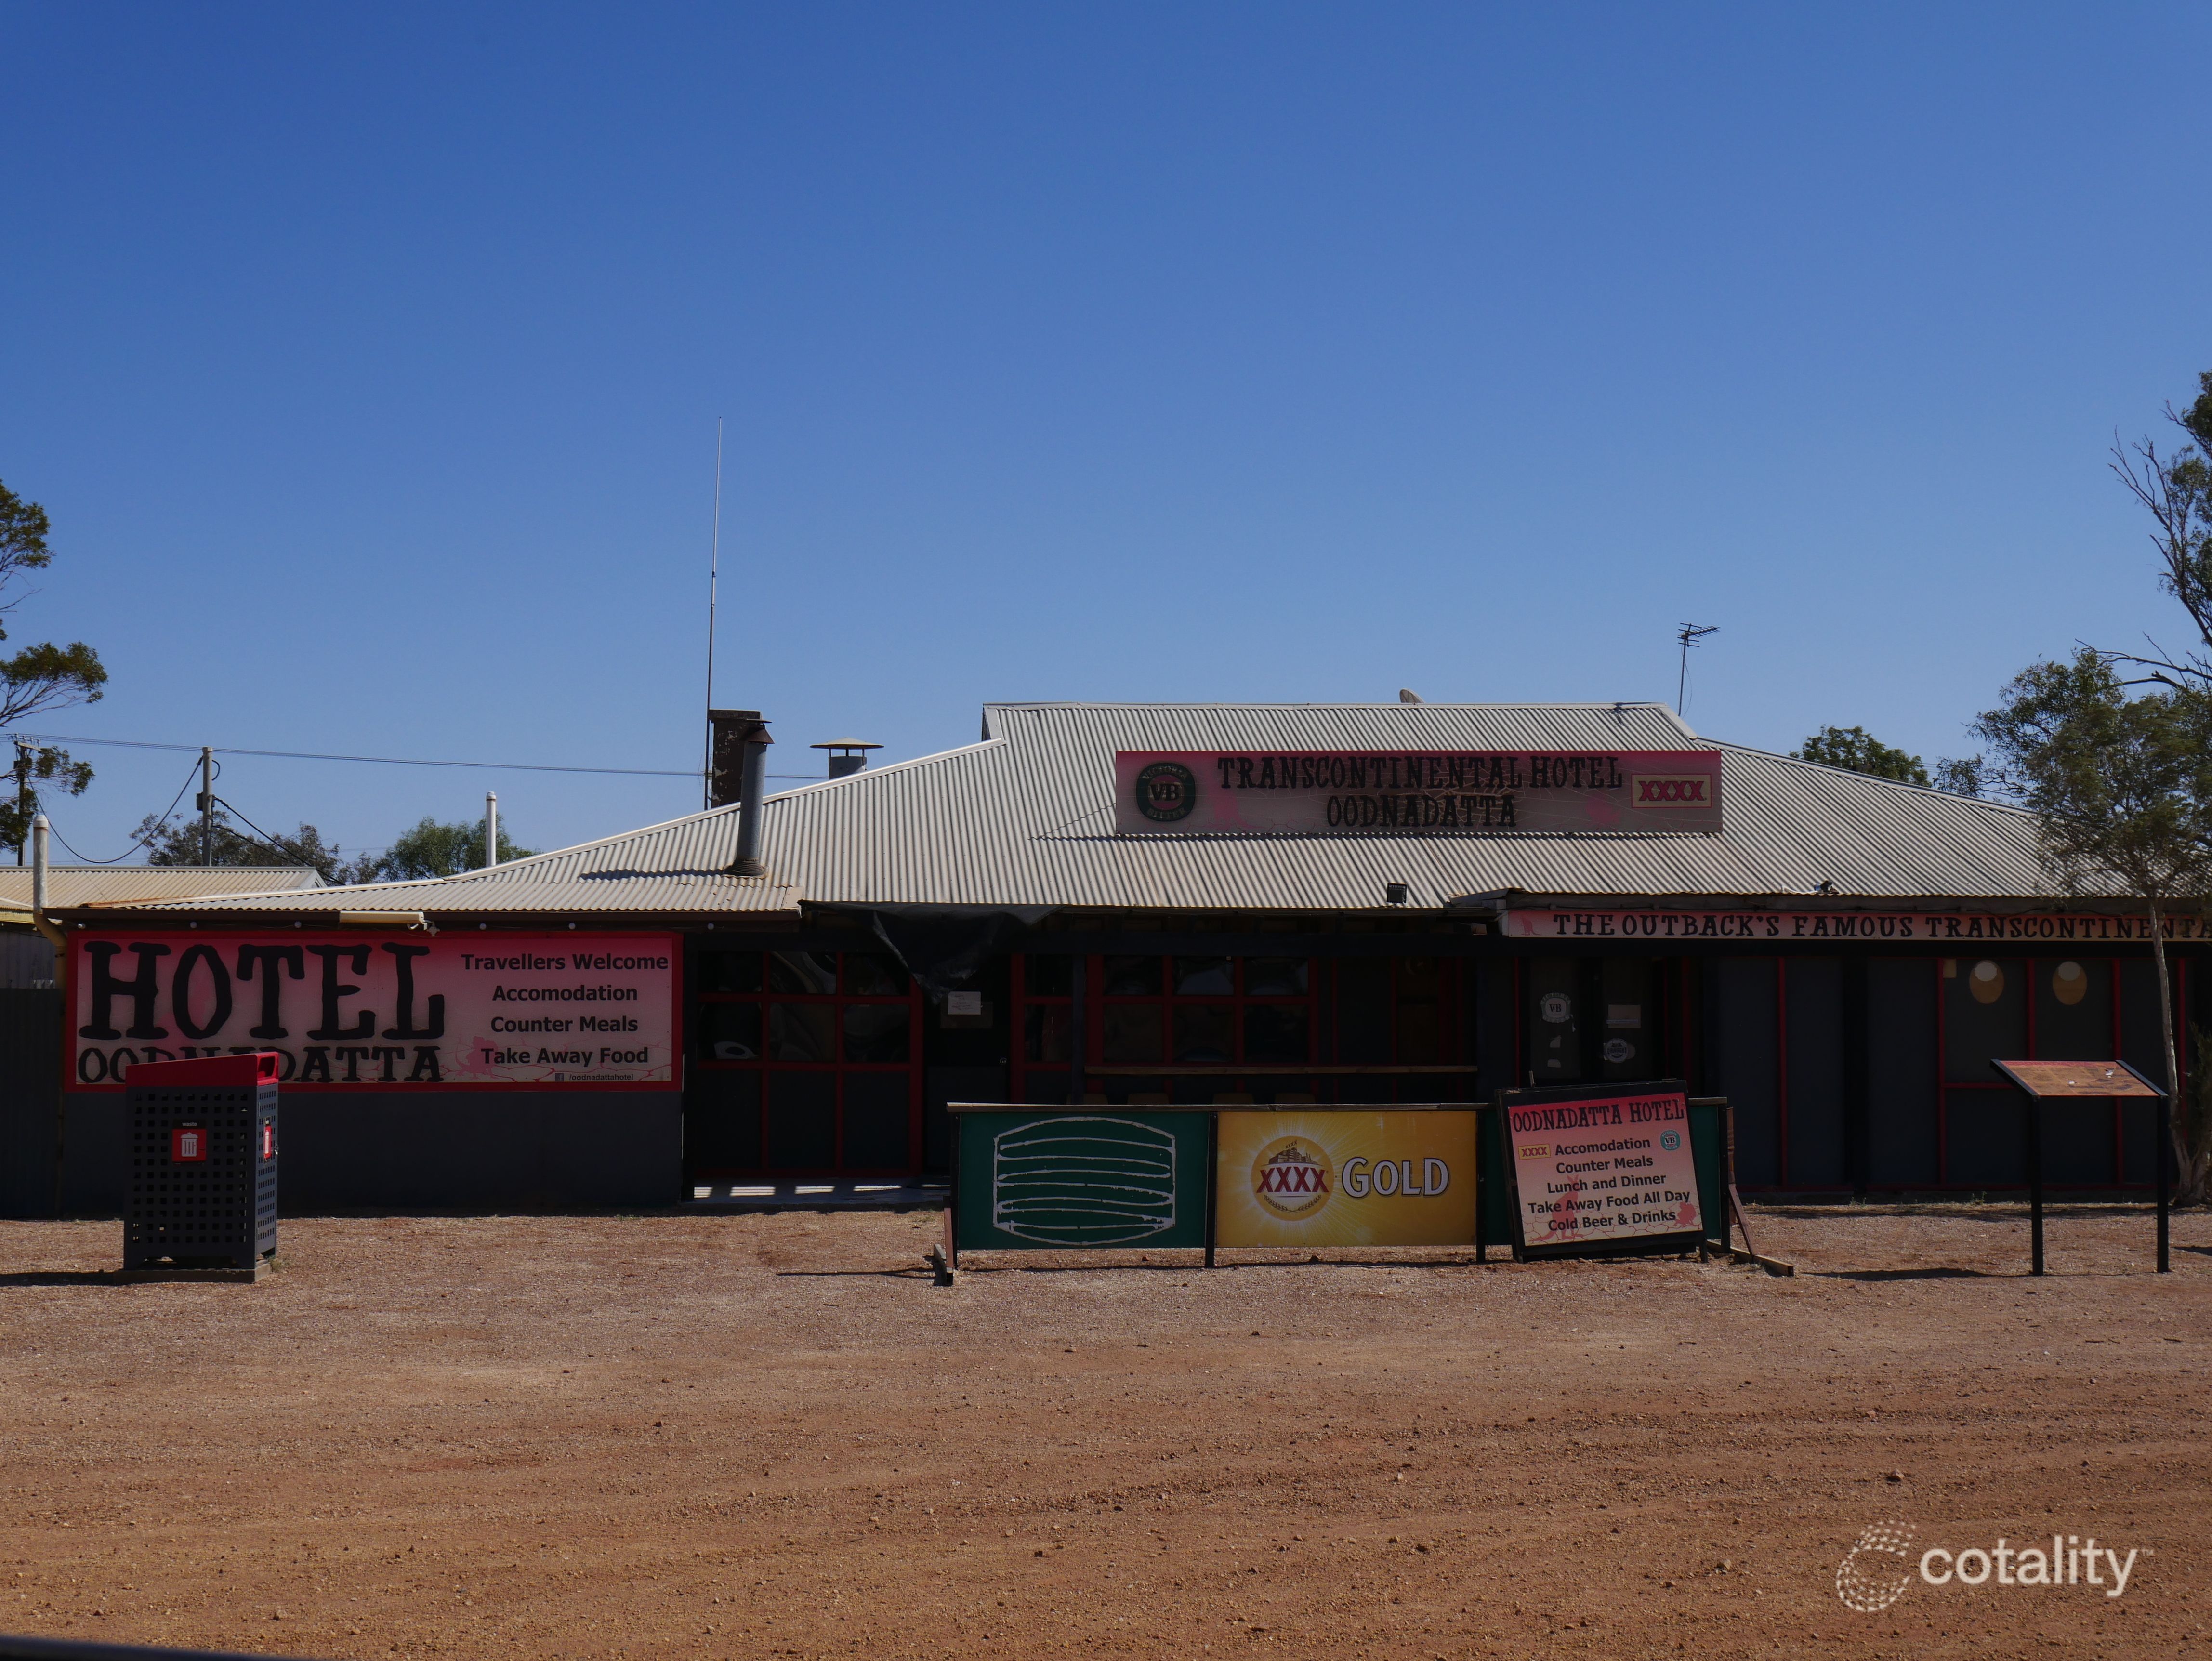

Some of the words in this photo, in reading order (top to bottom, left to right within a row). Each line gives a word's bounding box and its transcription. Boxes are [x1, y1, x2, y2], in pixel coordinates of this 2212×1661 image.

[1217, 756, 1522, 789] TRANSCONTINENTAL
[1529, 756, 1622, 789] HOTEL
[1148, 784, 1181, 801] VB
[1639, 780, 1705, 801] XXXX
[1327, 795, 1517, 827] OODNADATTA
[1554, 914, 1615, 935] THE
[1622, 915, 1779, 936] OUTBACK'S
[1791, 916, 1913, 937] FAMOUS
[461, 953, 566, 970] Travellers
[572, 953, 669, 970] Welcome
[79, 941, 445, 1040] HOTEL
[492, 985, 637, 1001] Accomodation
[1549, 1004, 1561, 1012] VB
[491, 1016, 573, 1032] Counter
[579, 1015, 638, 1032] Meals
[481, 1047, 530, 1064] Take
[537, 1048, 593, 1067] Away
[600, 1047, 648, 1064] Food
[1513, 1104, 1623, 1132] OODNADATTA
[1629, 1099, 1685, 1123] HOTEL
[1522, 1147, 1548, 1157] XXXX
[1555, 1137, 1651, 1156] Accomodation
[1556, 1160, 1610, 1174] Counter
[1614, 1156, 1653, 1169] Meals
[1256, 1166, 1329, 1193] XXXX
[1342, 1157, 1450, 1199] GOLD
[1547, 1180, 1588, 1193] Lunch
[1592, 1176, 1617, 1190] and
[1621, 1174, 1666, 1187] Dinner
[1528, 1201, 1561, 1213] Take
[1566, 1199, 1602, 1211] Away
[1606, 1194, 1639, 1207] Food
[1644, 1192, 1660, 1203] All
[1665, 1191, 1691, 1203] Day
[1548, 1218, 1578, 1231] Cold
[1583, 1216, 1614, 1228] Beer
[1618, 1213, 1629, 1225] &
[1633, 1210, 1676, 1224] Drinks
